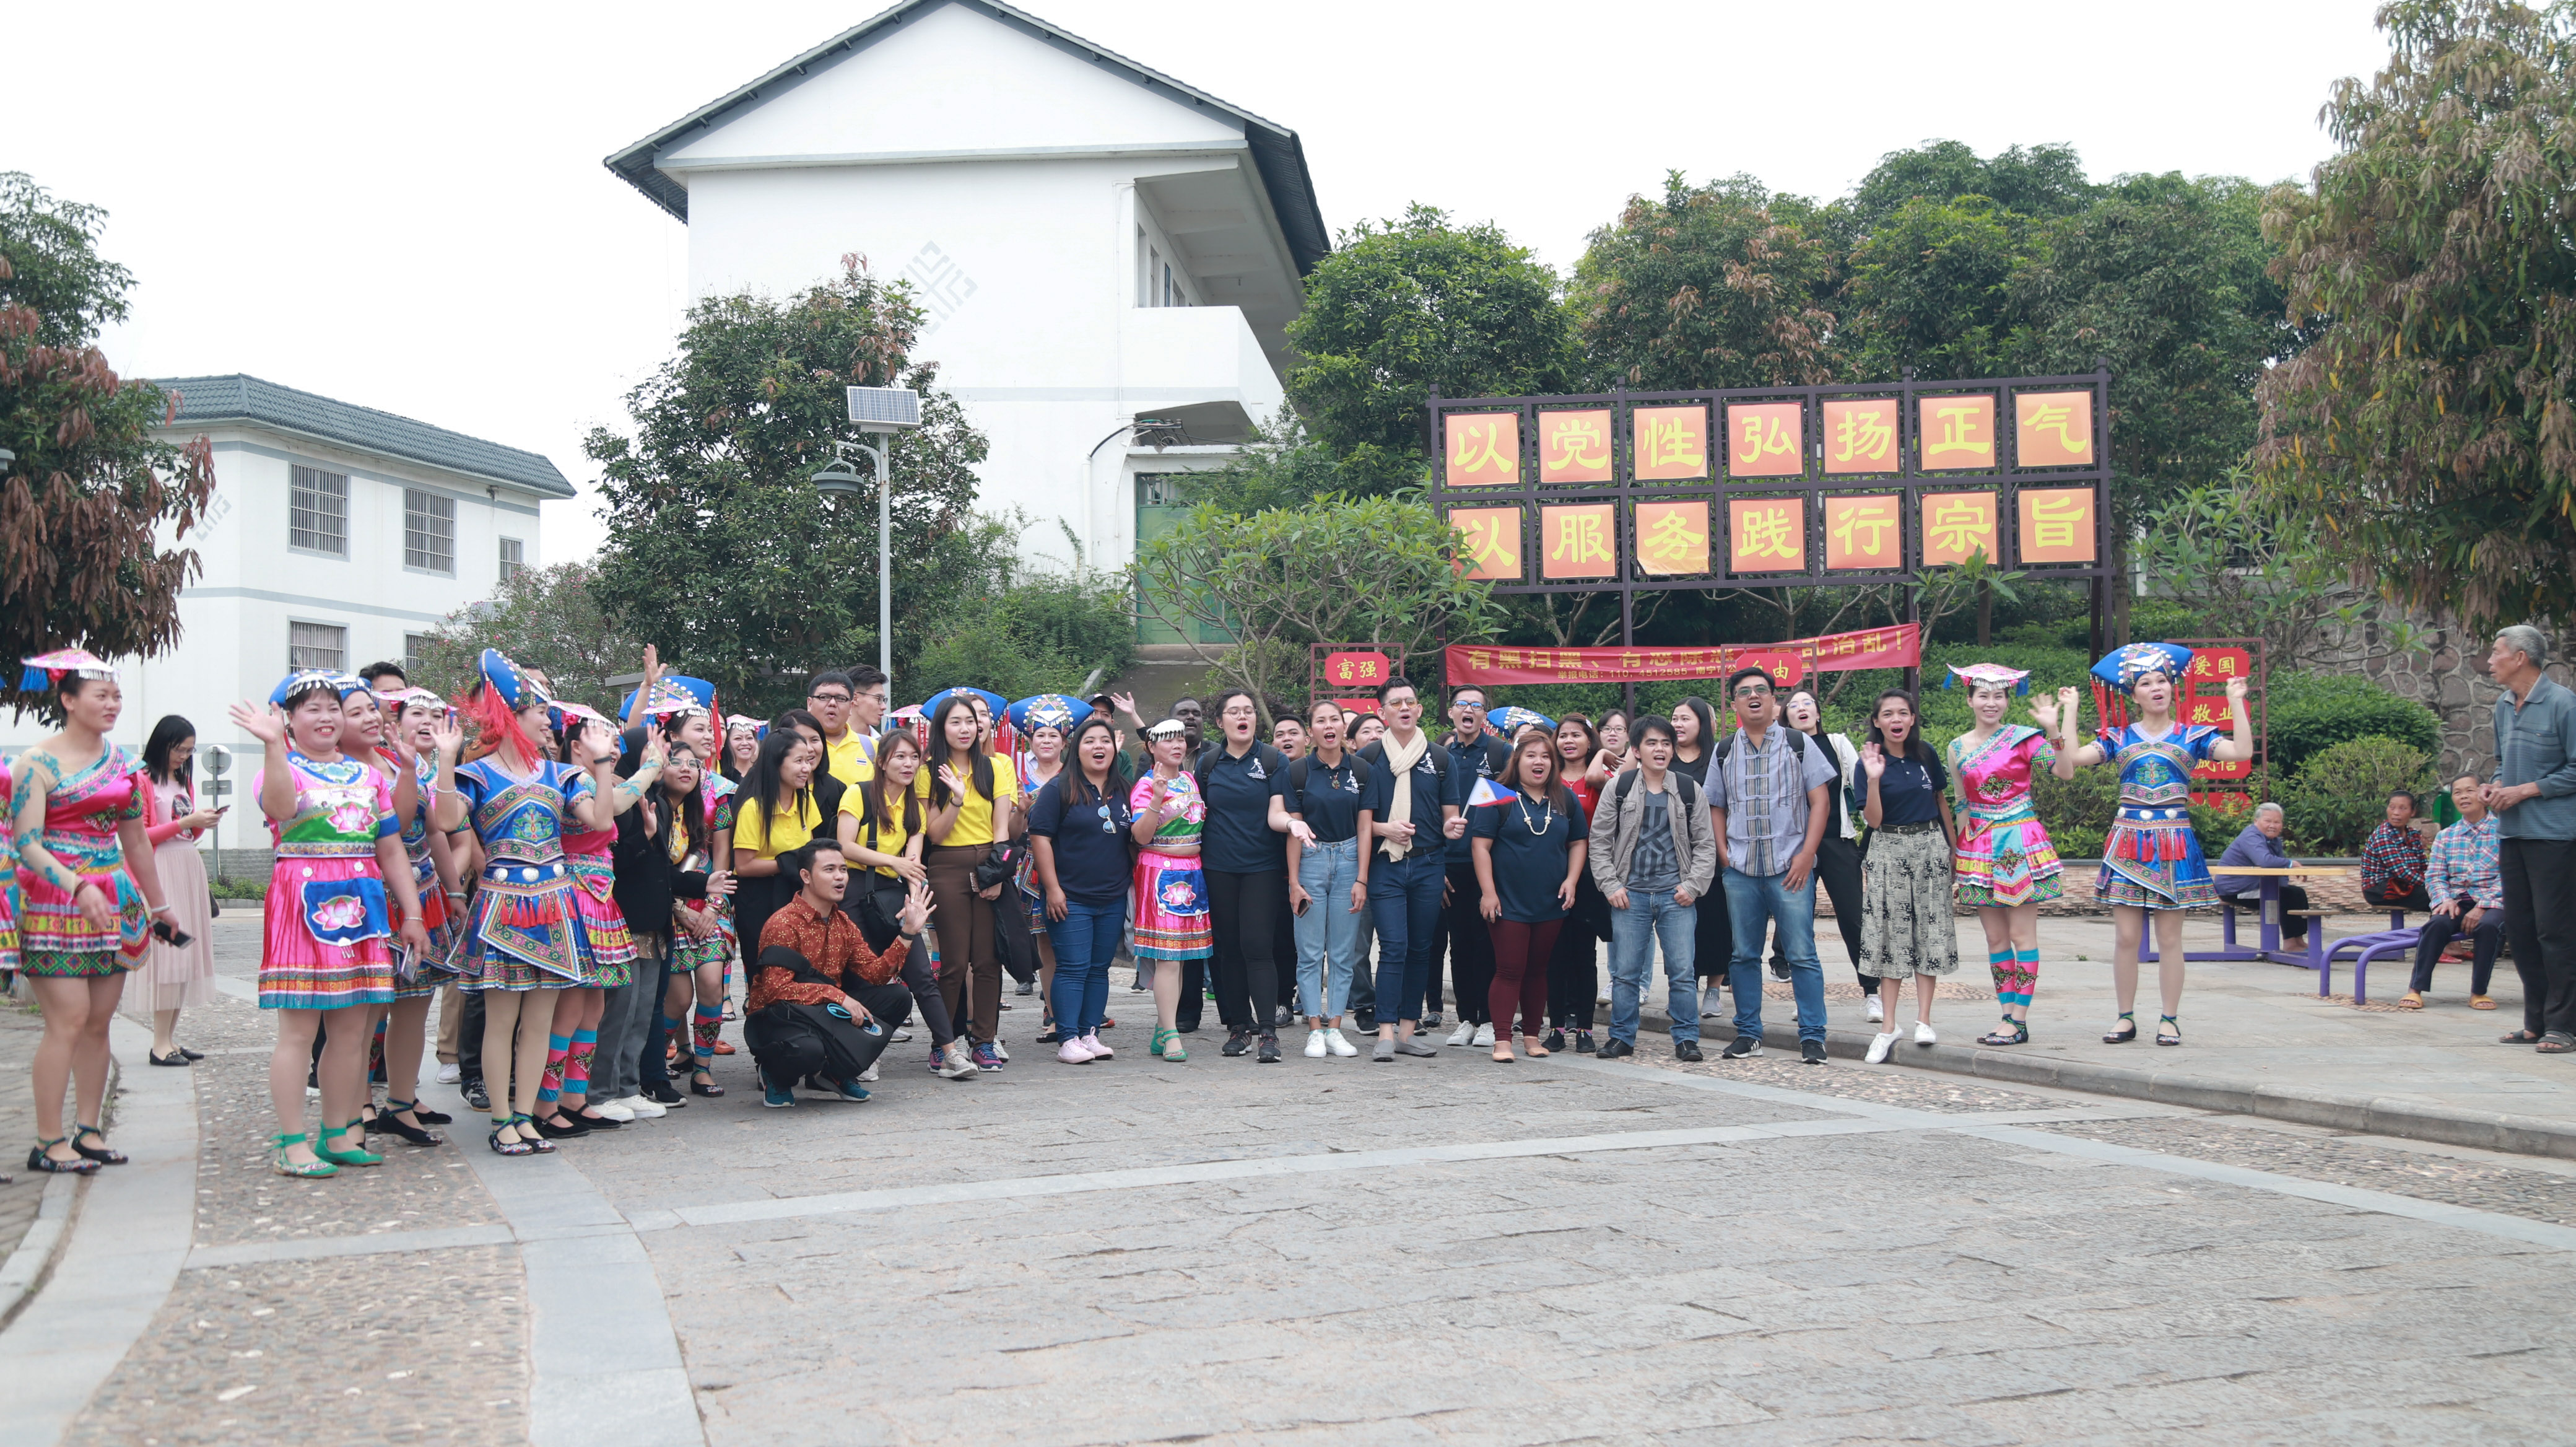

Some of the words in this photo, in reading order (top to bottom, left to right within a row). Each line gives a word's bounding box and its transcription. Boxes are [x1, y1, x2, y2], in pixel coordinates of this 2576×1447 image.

[1454, 403, 2087, 473] 以党性弘扬正气
[1456, 496, 2086, 567] 以服务践行宗旨
[1337, 658, 1378, 680] 富强
[2194, 655, 2235, 676] 爱国
